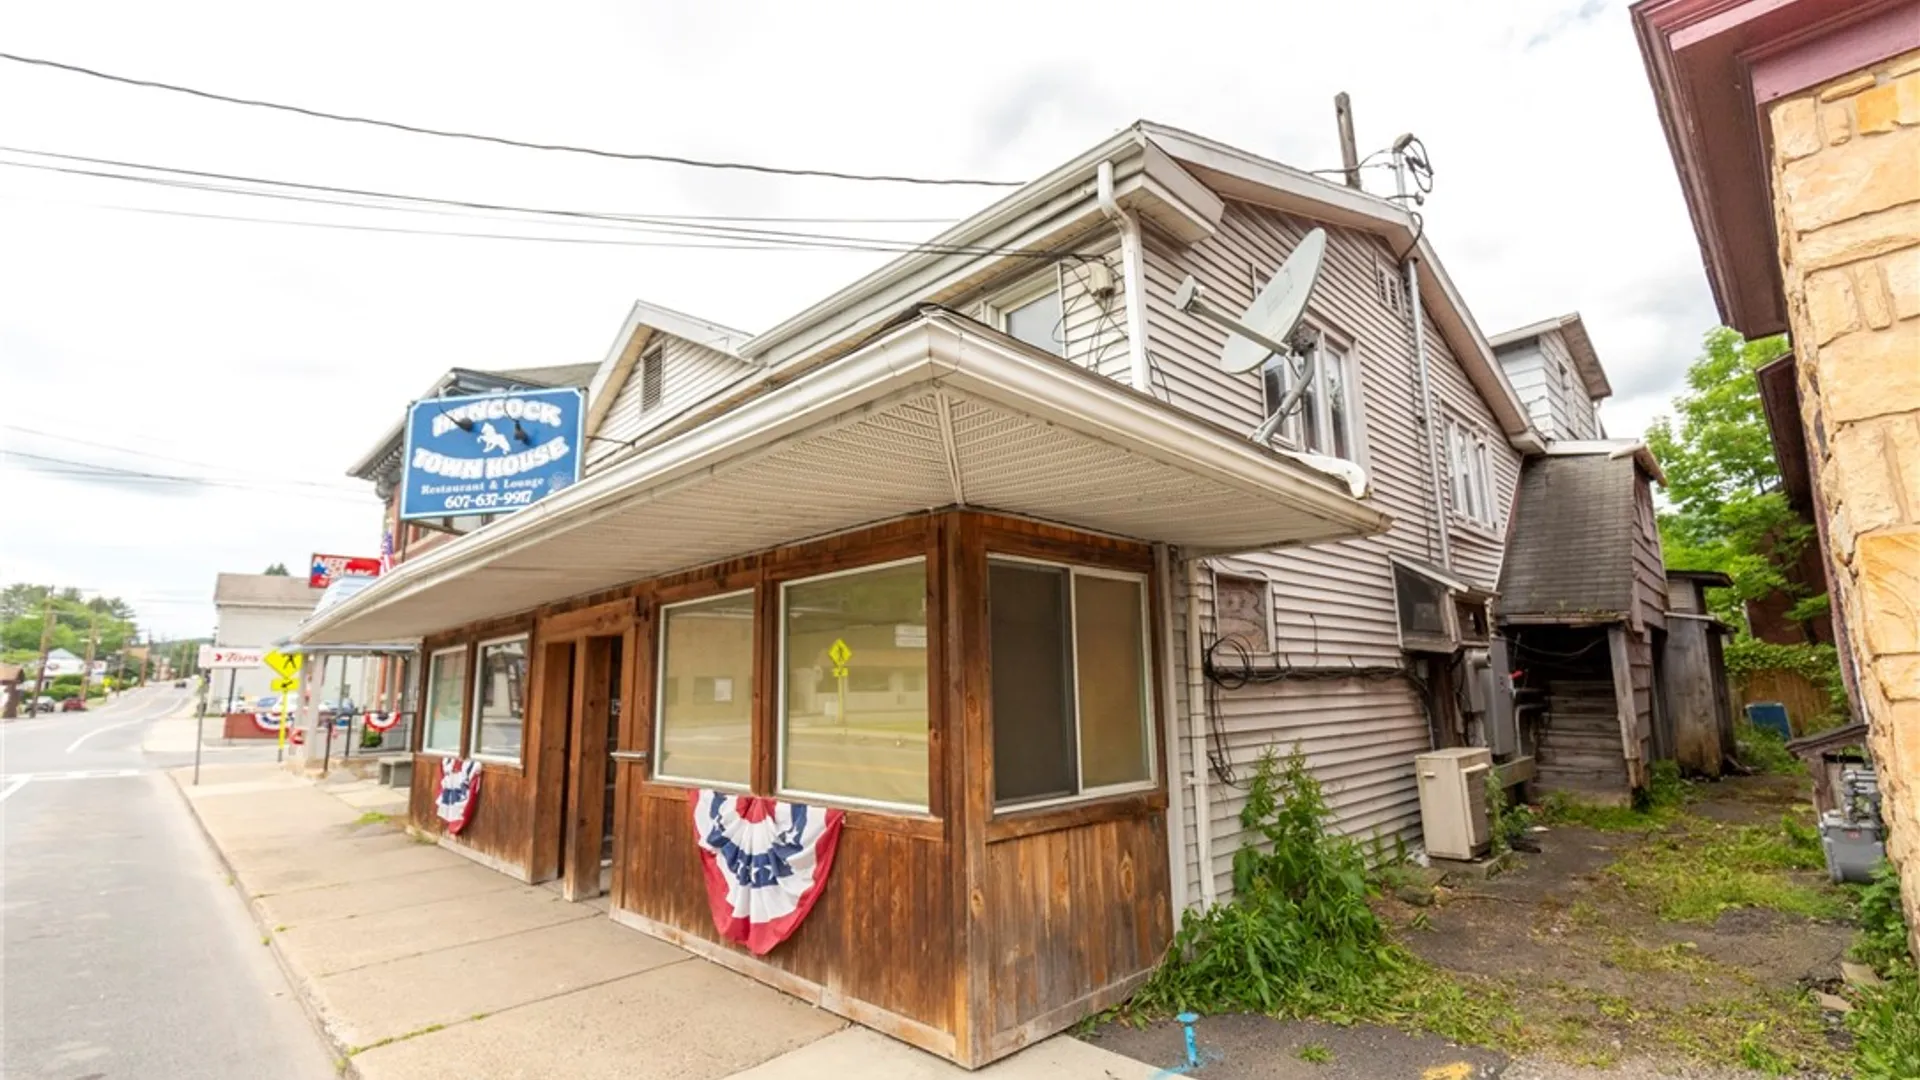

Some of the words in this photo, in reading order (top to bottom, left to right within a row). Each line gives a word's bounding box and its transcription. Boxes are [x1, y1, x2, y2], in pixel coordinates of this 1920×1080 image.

[412, 447, 484, 479] TOWN
[485, 436, 570, 479] HOUSE
[421, 483, 484, 495] Restaurant
[489, 479, 498, 490] &
[503, 478, 544, 489] Lounge
[444, 491, 533, 508] 607-637-9917
